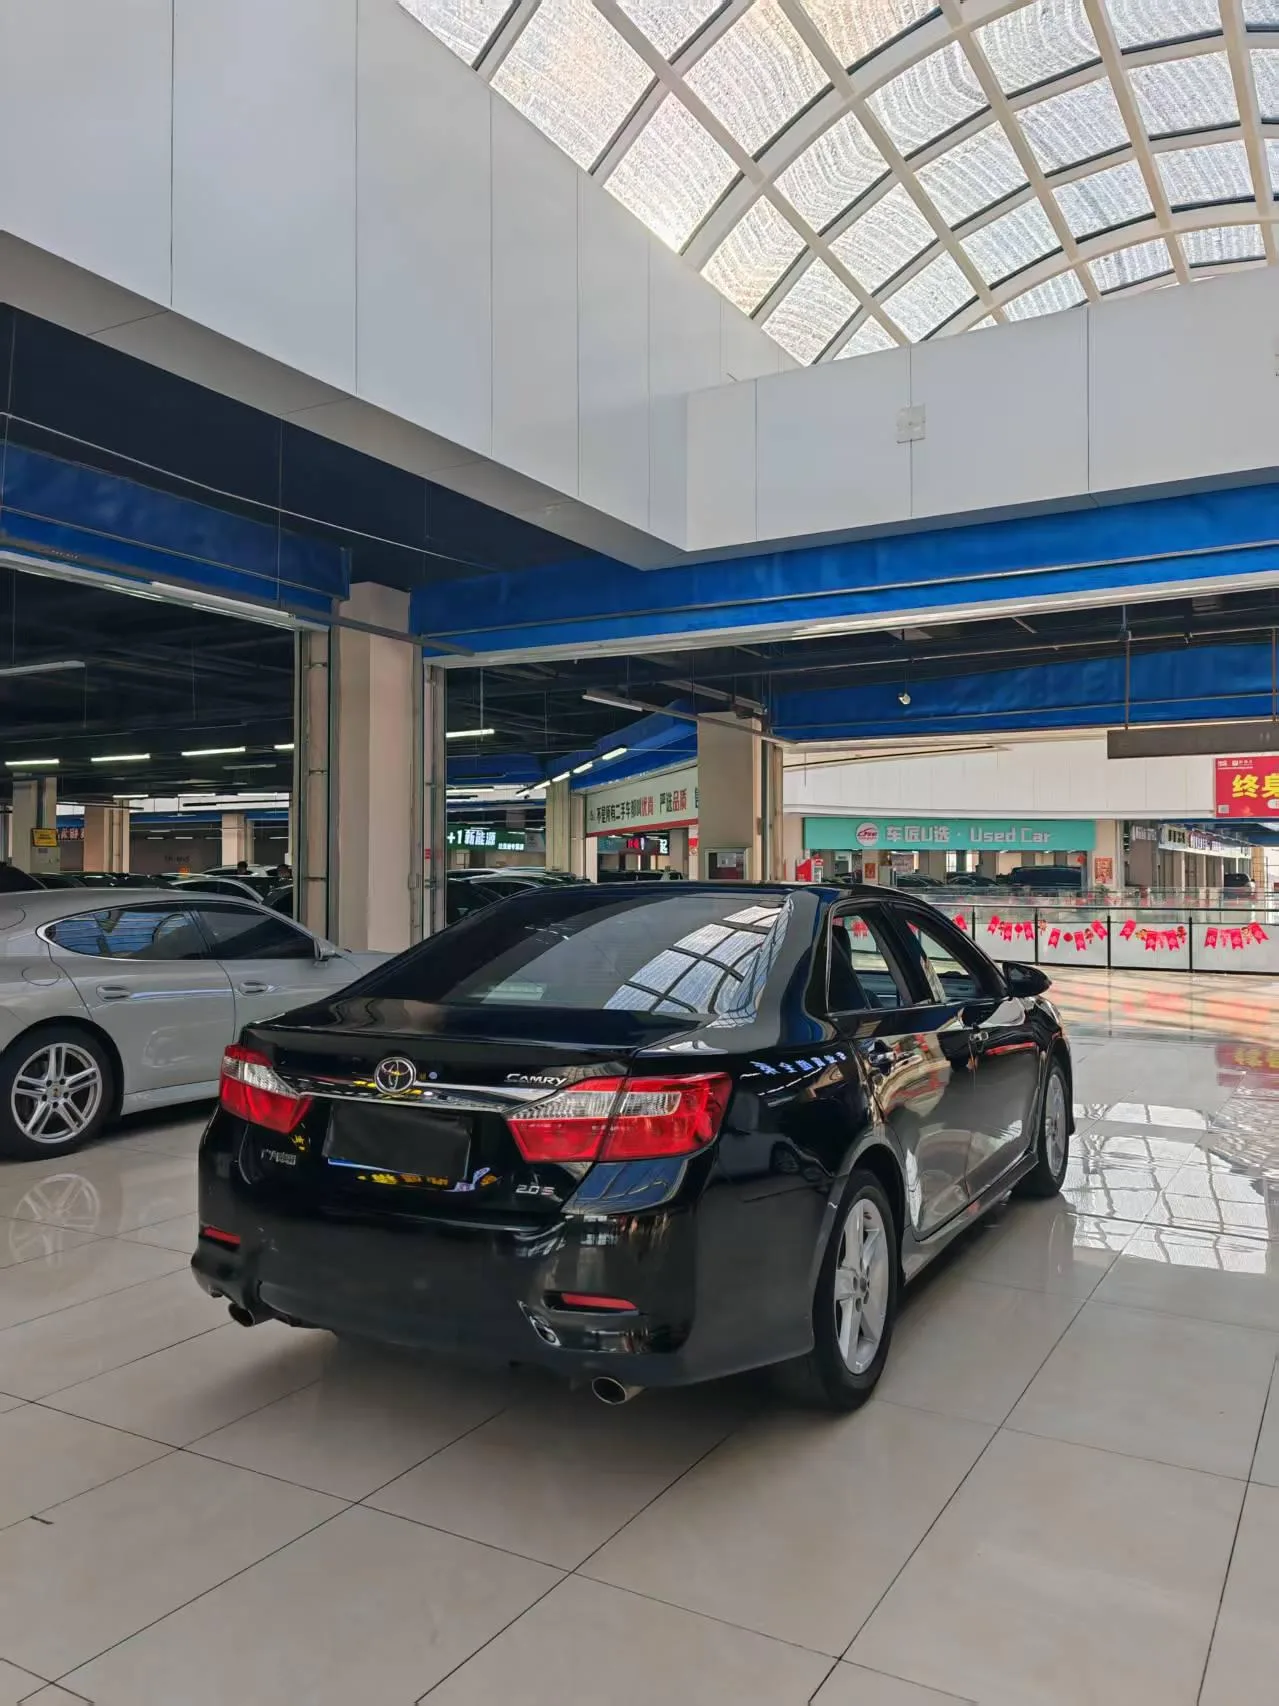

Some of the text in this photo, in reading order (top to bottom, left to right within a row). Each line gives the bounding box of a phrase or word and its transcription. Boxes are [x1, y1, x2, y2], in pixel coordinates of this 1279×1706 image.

[970, 827, 1016, 843] Used
[1020, 827, 1051, 843] Car
[504, 1073, 568, 1087] CAMRY
